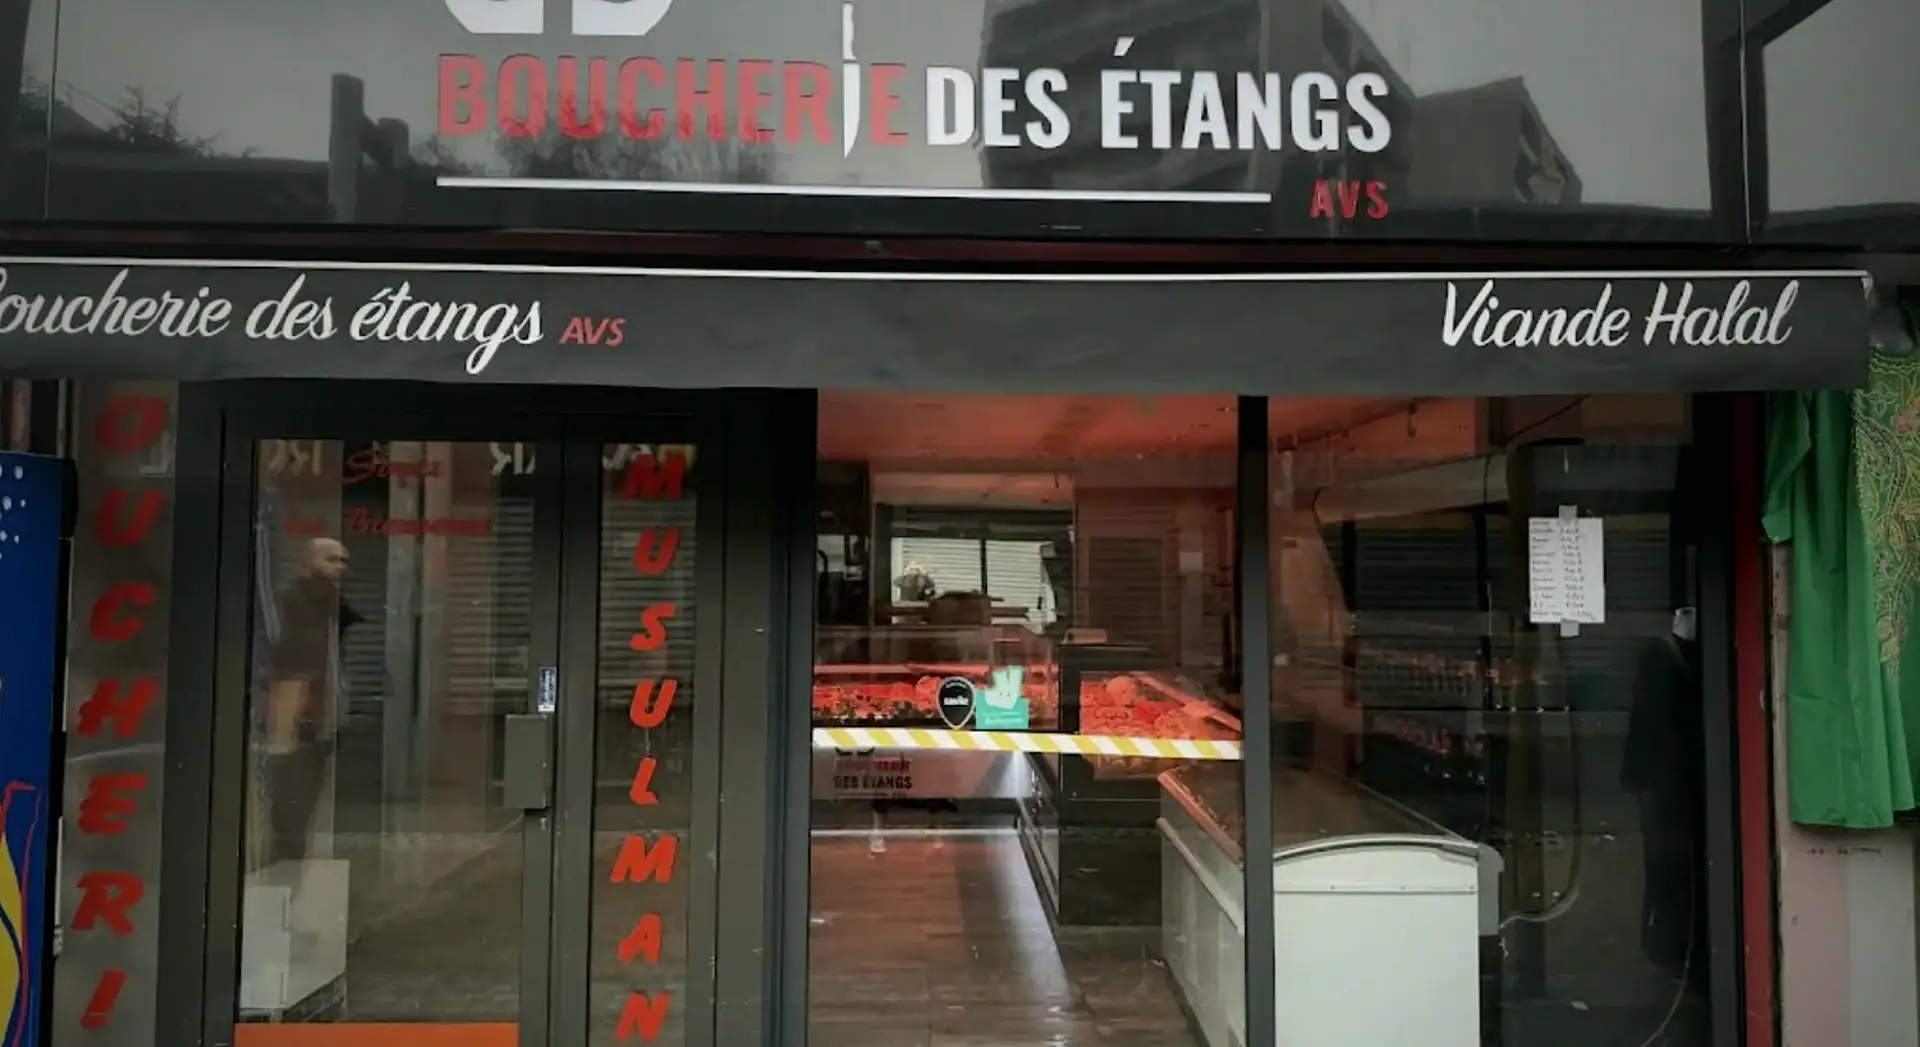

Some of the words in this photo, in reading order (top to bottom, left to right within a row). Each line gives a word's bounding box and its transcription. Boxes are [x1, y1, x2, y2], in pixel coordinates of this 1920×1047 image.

[437, 52, 909, 150] BOUCHERIE
[926, 66, 1070, 149] DES
[1101, 37, 1391, 153] ÉTANGS
[1310, 180, 1389, 219] AVS
[245, 274, 338, 340] des
[350, 281, 543, 375] étangs
[559, 315, 627, 347] AVS
[1441, 280, 1630, 347] Viande
[1643, 280, 1799, 346] Halal
[611, 453, 687, 1041] MUSULMAN
